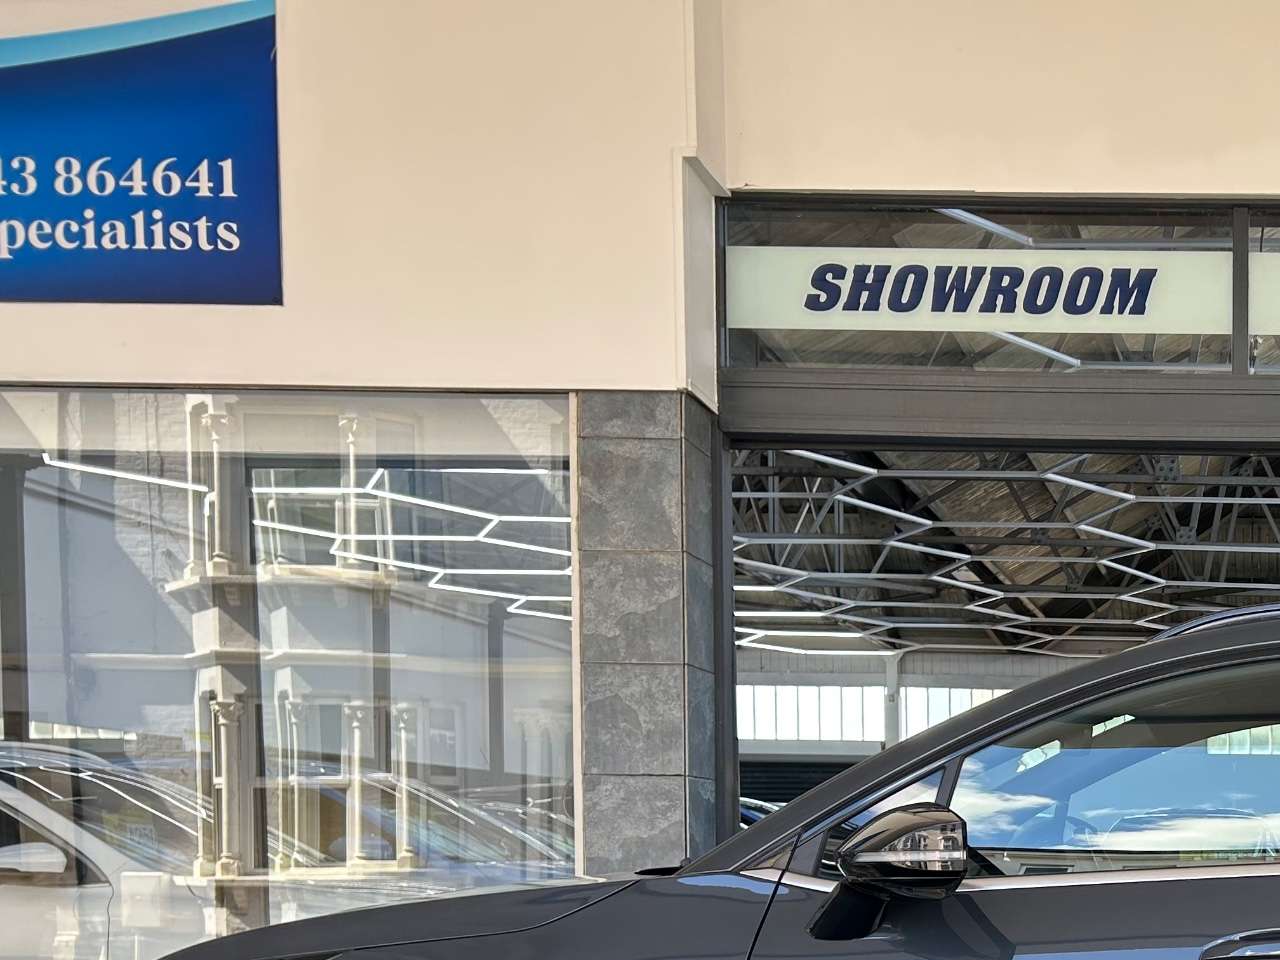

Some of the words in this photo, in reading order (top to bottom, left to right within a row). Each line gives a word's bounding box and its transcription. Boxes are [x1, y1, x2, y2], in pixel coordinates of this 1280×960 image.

[53, 155, 239, 198] 864641
[0, 208, 241, 260] pecialists
[803, 262, 1158, 317] SHOWROOM
